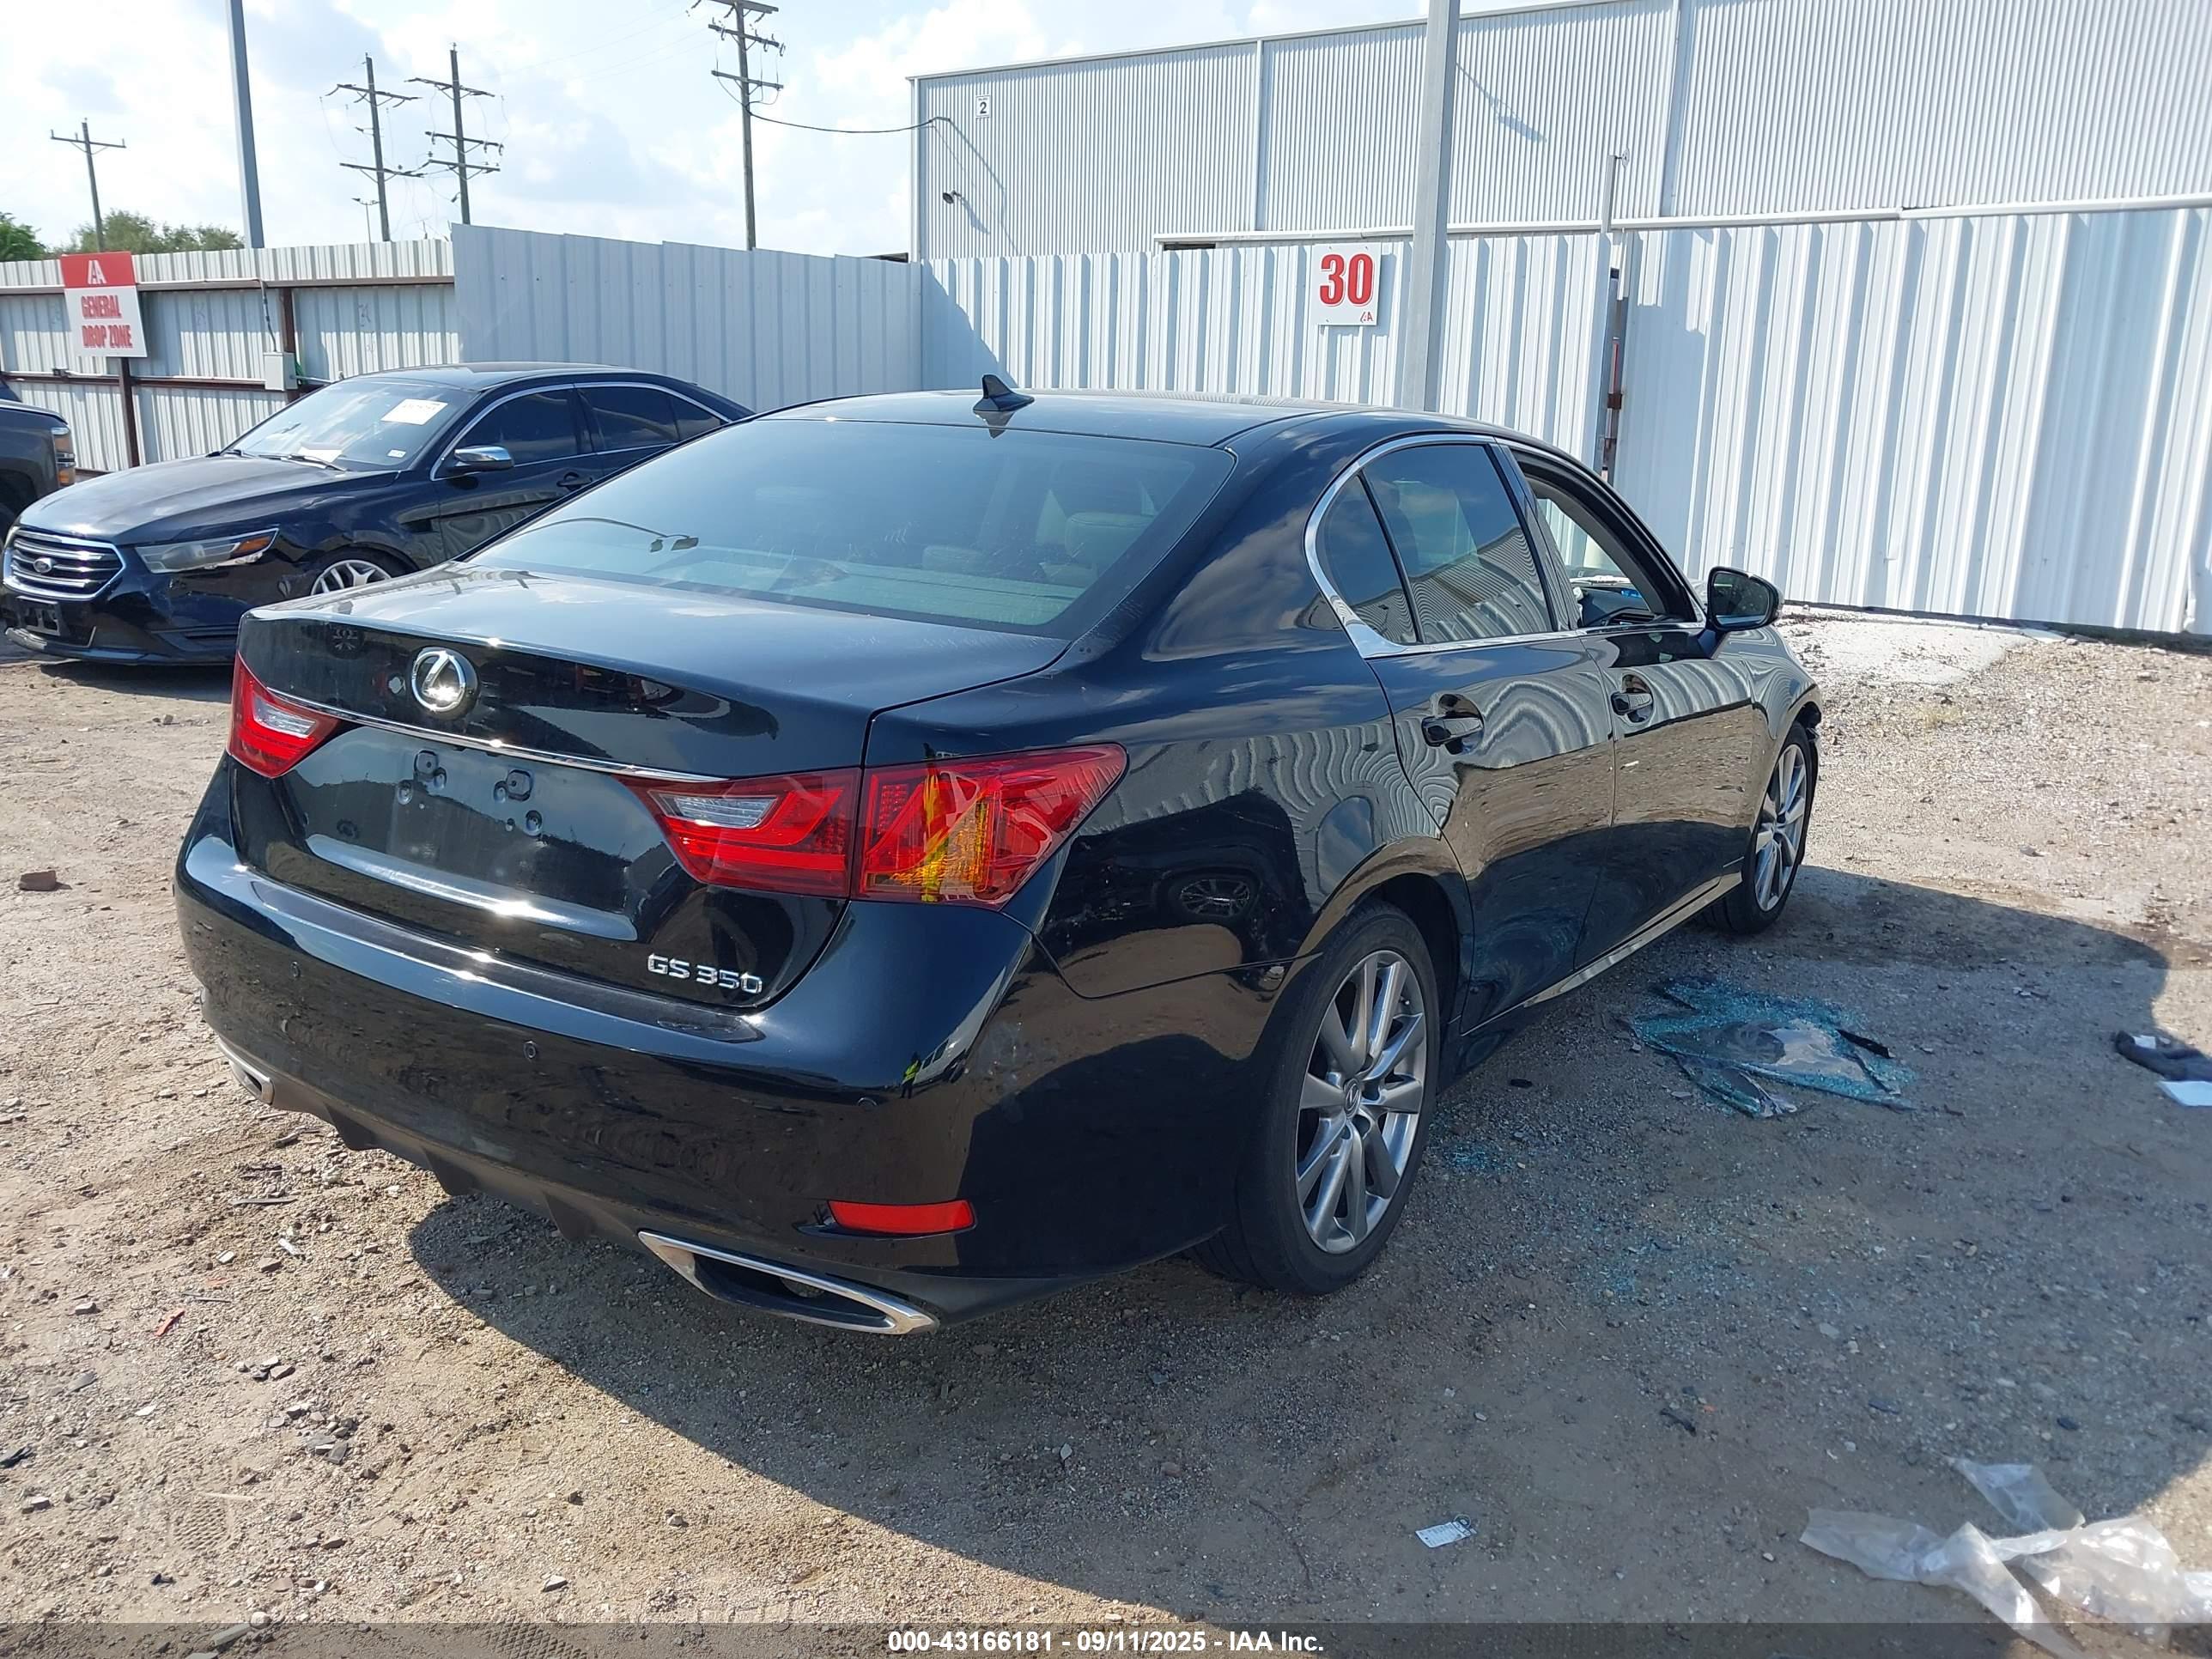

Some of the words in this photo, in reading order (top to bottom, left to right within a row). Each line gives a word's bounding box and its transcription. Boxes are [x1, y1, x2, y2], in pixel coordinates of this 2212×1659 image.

[979, 101, 988, 114] 2
[1319, 252, 1374, 306] 30
[81, 295, 123, 319] GENERAL
[82, 325, 106, 348] DROP
[108, 325, 133, 349] ZONE
[647, 952, 690, 980] GS
[696, 963, 763, 994] 350
